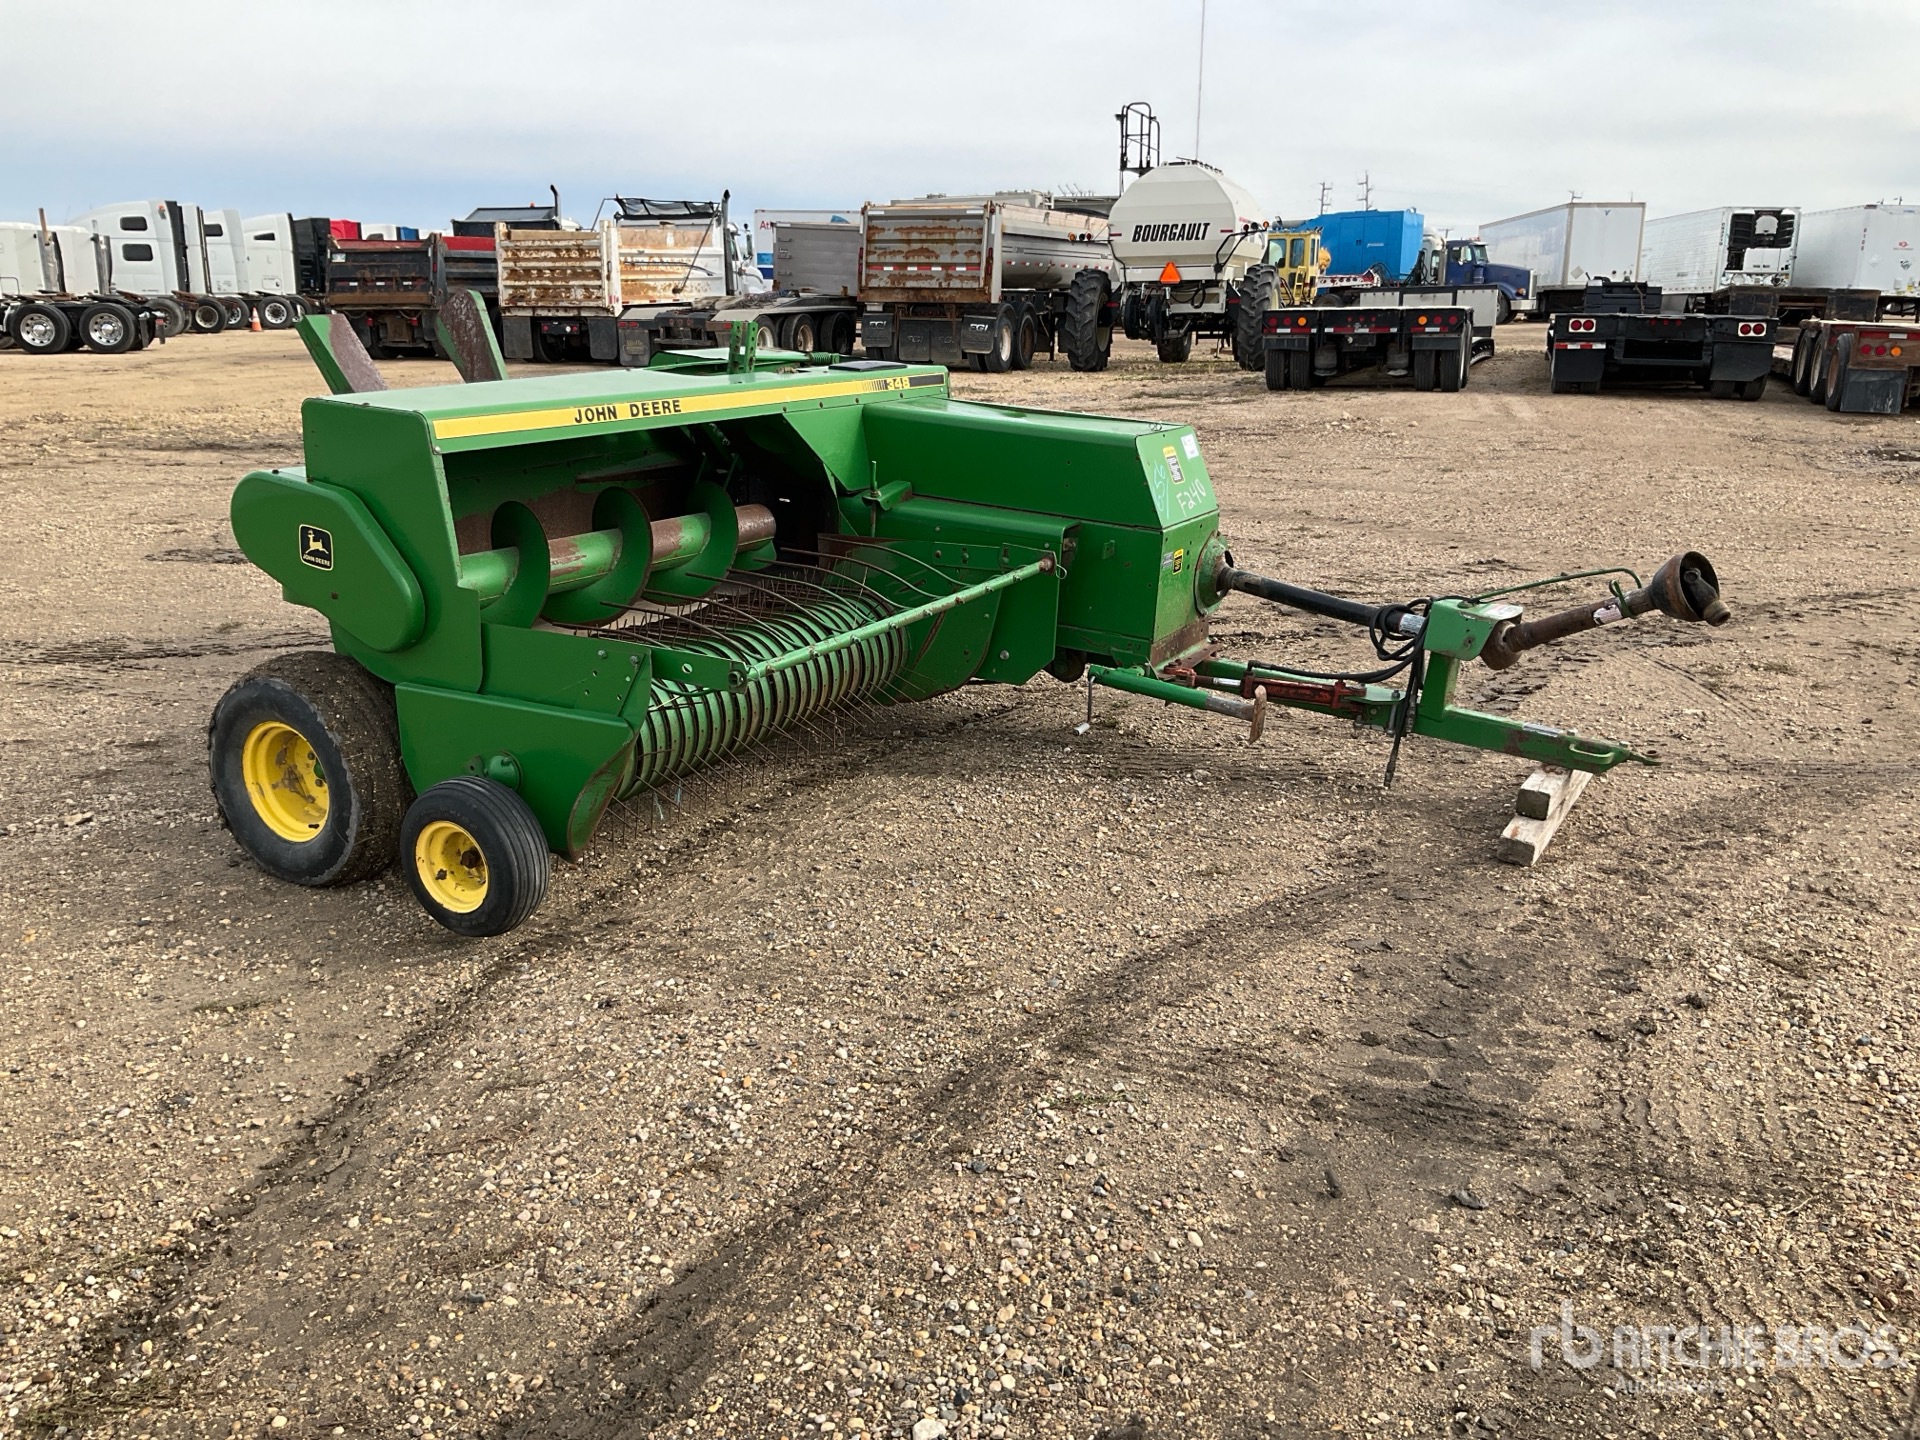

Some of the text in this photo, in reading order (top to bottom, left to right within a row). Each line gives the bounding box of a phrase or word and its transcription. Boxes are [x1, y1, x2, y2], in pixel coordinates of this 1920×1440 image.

[1131, 223, 1211, 242] BOURGAULT
[886, 376, 911, 391] 348
[574, 399, 682, 423] JOHN DEERE
[1176, 479, 1207, 518] F240
[303, 554, 330, 566] JOHN DEERE
